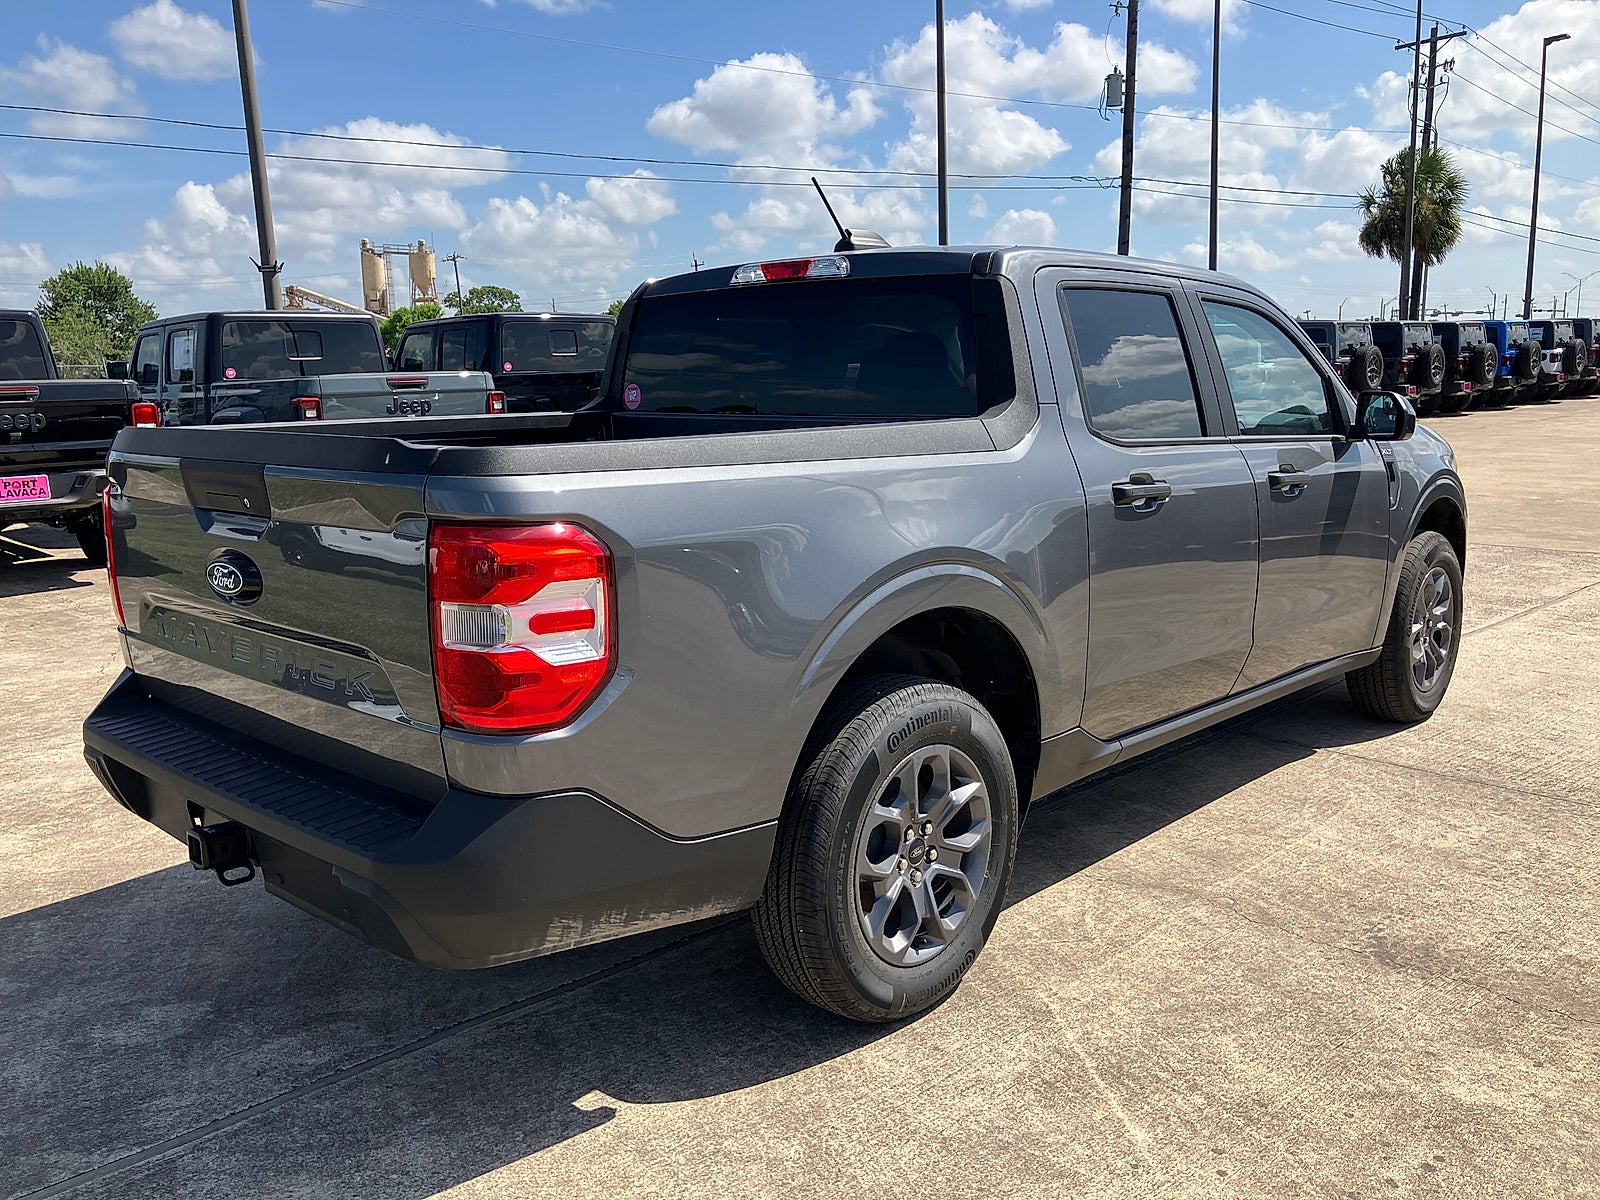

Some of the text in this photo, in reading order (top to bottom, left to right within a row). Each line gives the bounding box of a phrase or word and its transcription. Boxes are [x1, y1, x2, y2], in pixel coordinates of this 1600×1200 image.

[386, 395, 432, 416] Jeep
[0, 413, 46, 432] eep
[0, 488, 47, 498] LAVACA
[3, 480, 38, 490] PORT
[212, 566, 235, 589] Ford
[155, 611, 375, 701] MAVERICK
[887, 706, 953, 754] Continental
